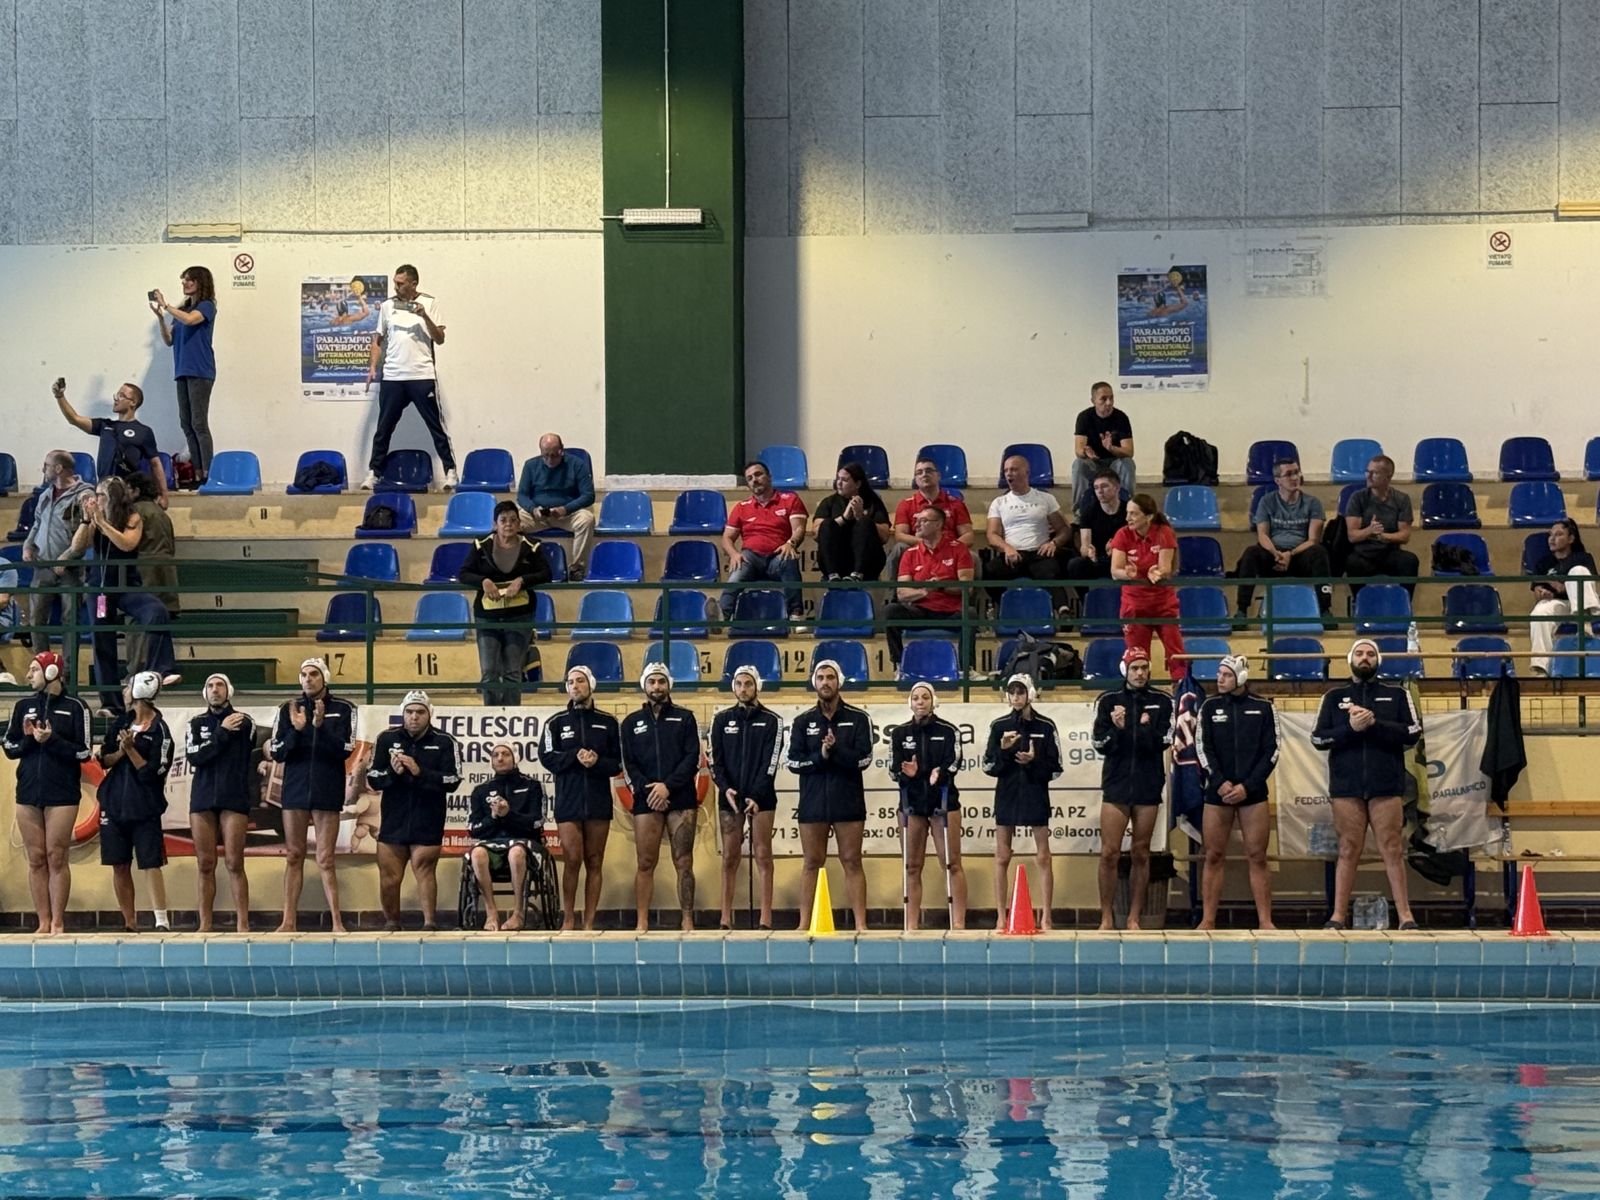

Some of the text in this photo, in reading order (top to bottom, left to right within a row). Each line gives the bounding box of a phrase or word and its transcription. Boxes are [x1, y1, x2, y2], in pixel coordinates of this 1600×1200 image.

[1133, 327, 1190, 336] PARALYMPIC
[316, 336, 372, 344] PARALYMPIC
[1132, 335, 1191, 343] WATERPOLO
[415, 652, 439, 676] 16
[782, 650, 806, 673] 12
[143, 675, 155, 686] 2
[436, 716, 539, 738] TELESCA
[1068, 806, 1086, 818] PZ
